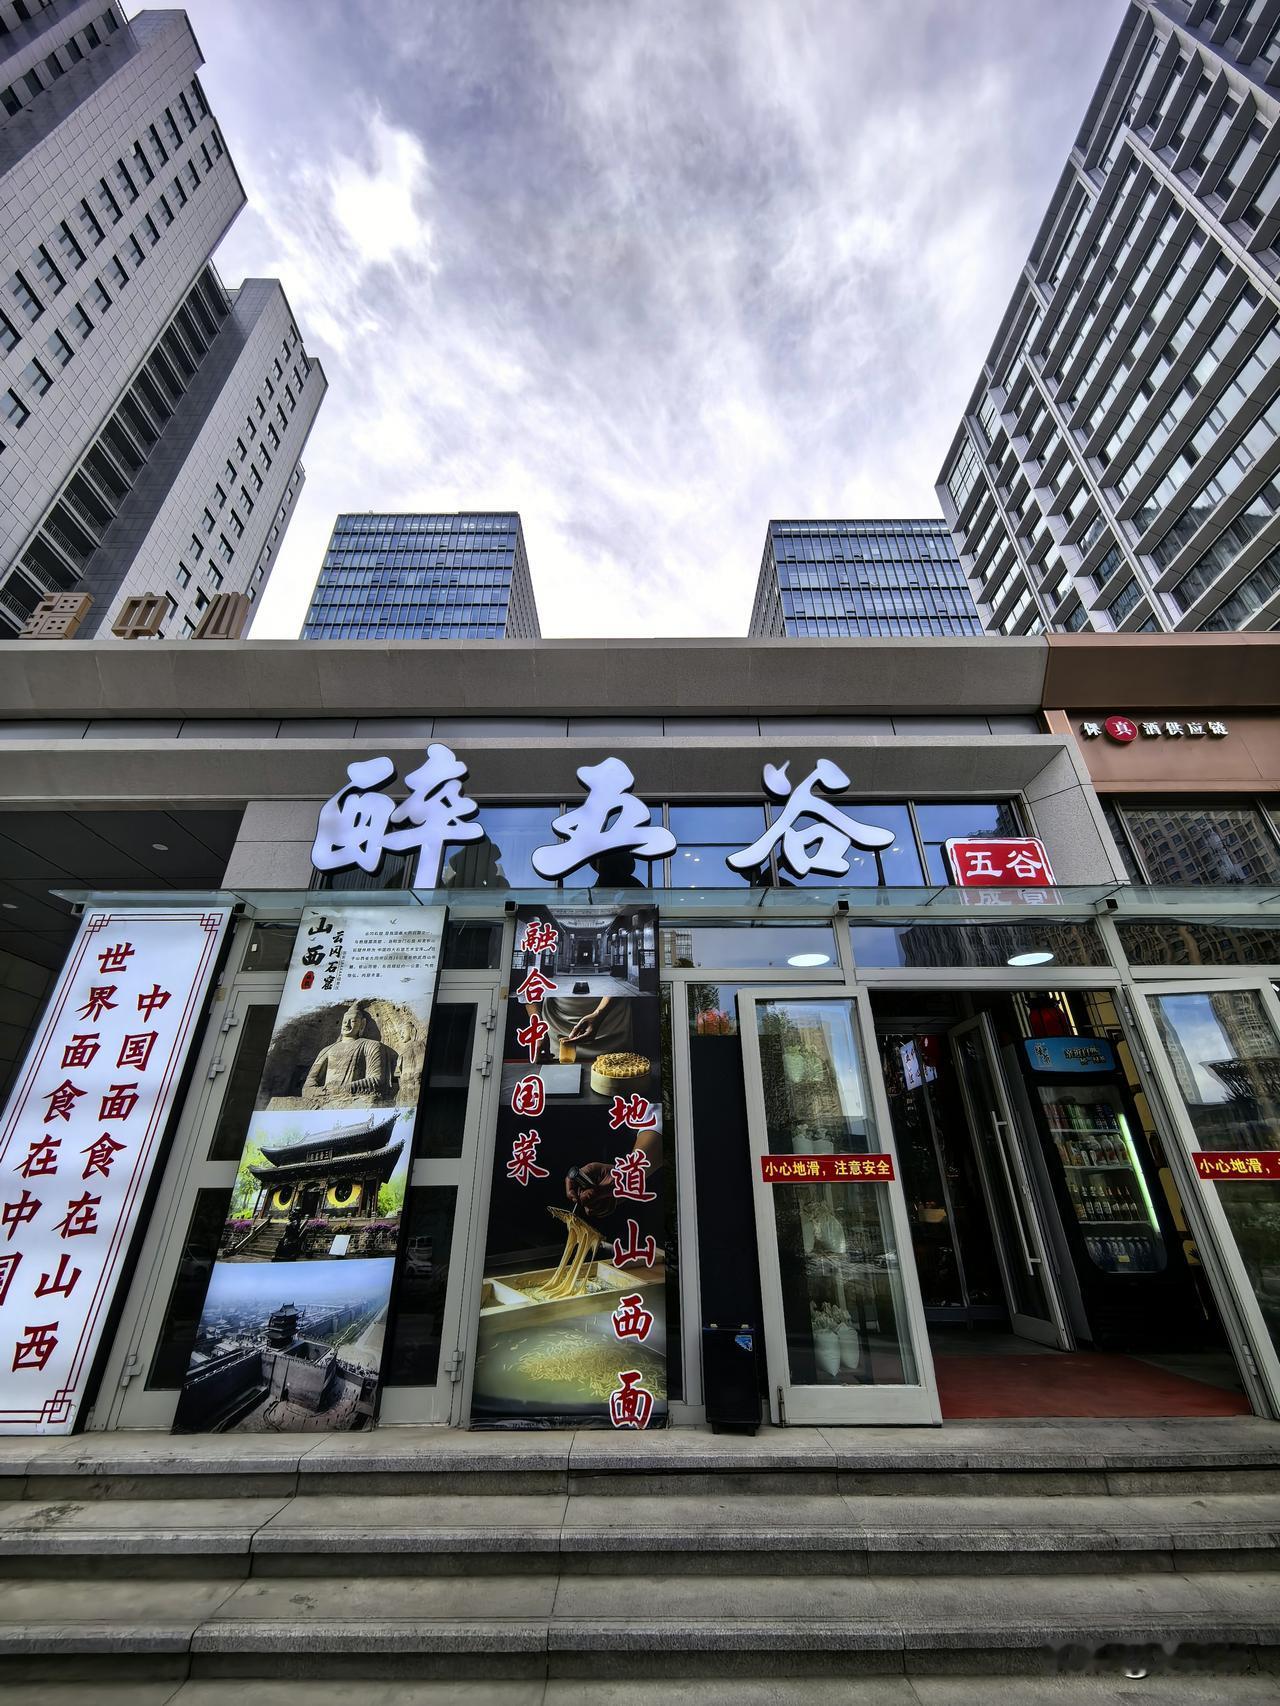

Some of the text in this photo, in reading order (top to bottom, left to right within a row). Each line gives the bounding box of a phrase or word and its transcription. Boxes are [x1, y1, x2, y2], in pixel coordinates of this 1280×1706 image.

[310, 743, 896, 889] 醉五谷
[964, 850, 1043, 878] 五谷
[301, 916, 333, 966] 山西
[321, 930, 345, 990] 云冈石窟
[506, 921, 558, 1188] 融合中国菜
[12, 983, 172, 1372] 中国面食在山西
[765, 1160, 891, 1177] 小心地滑，注意安全
[1200, 1158, 1280, 1174] 小心地滑，
[607, 1094, 657, 1430] 地道山西面
